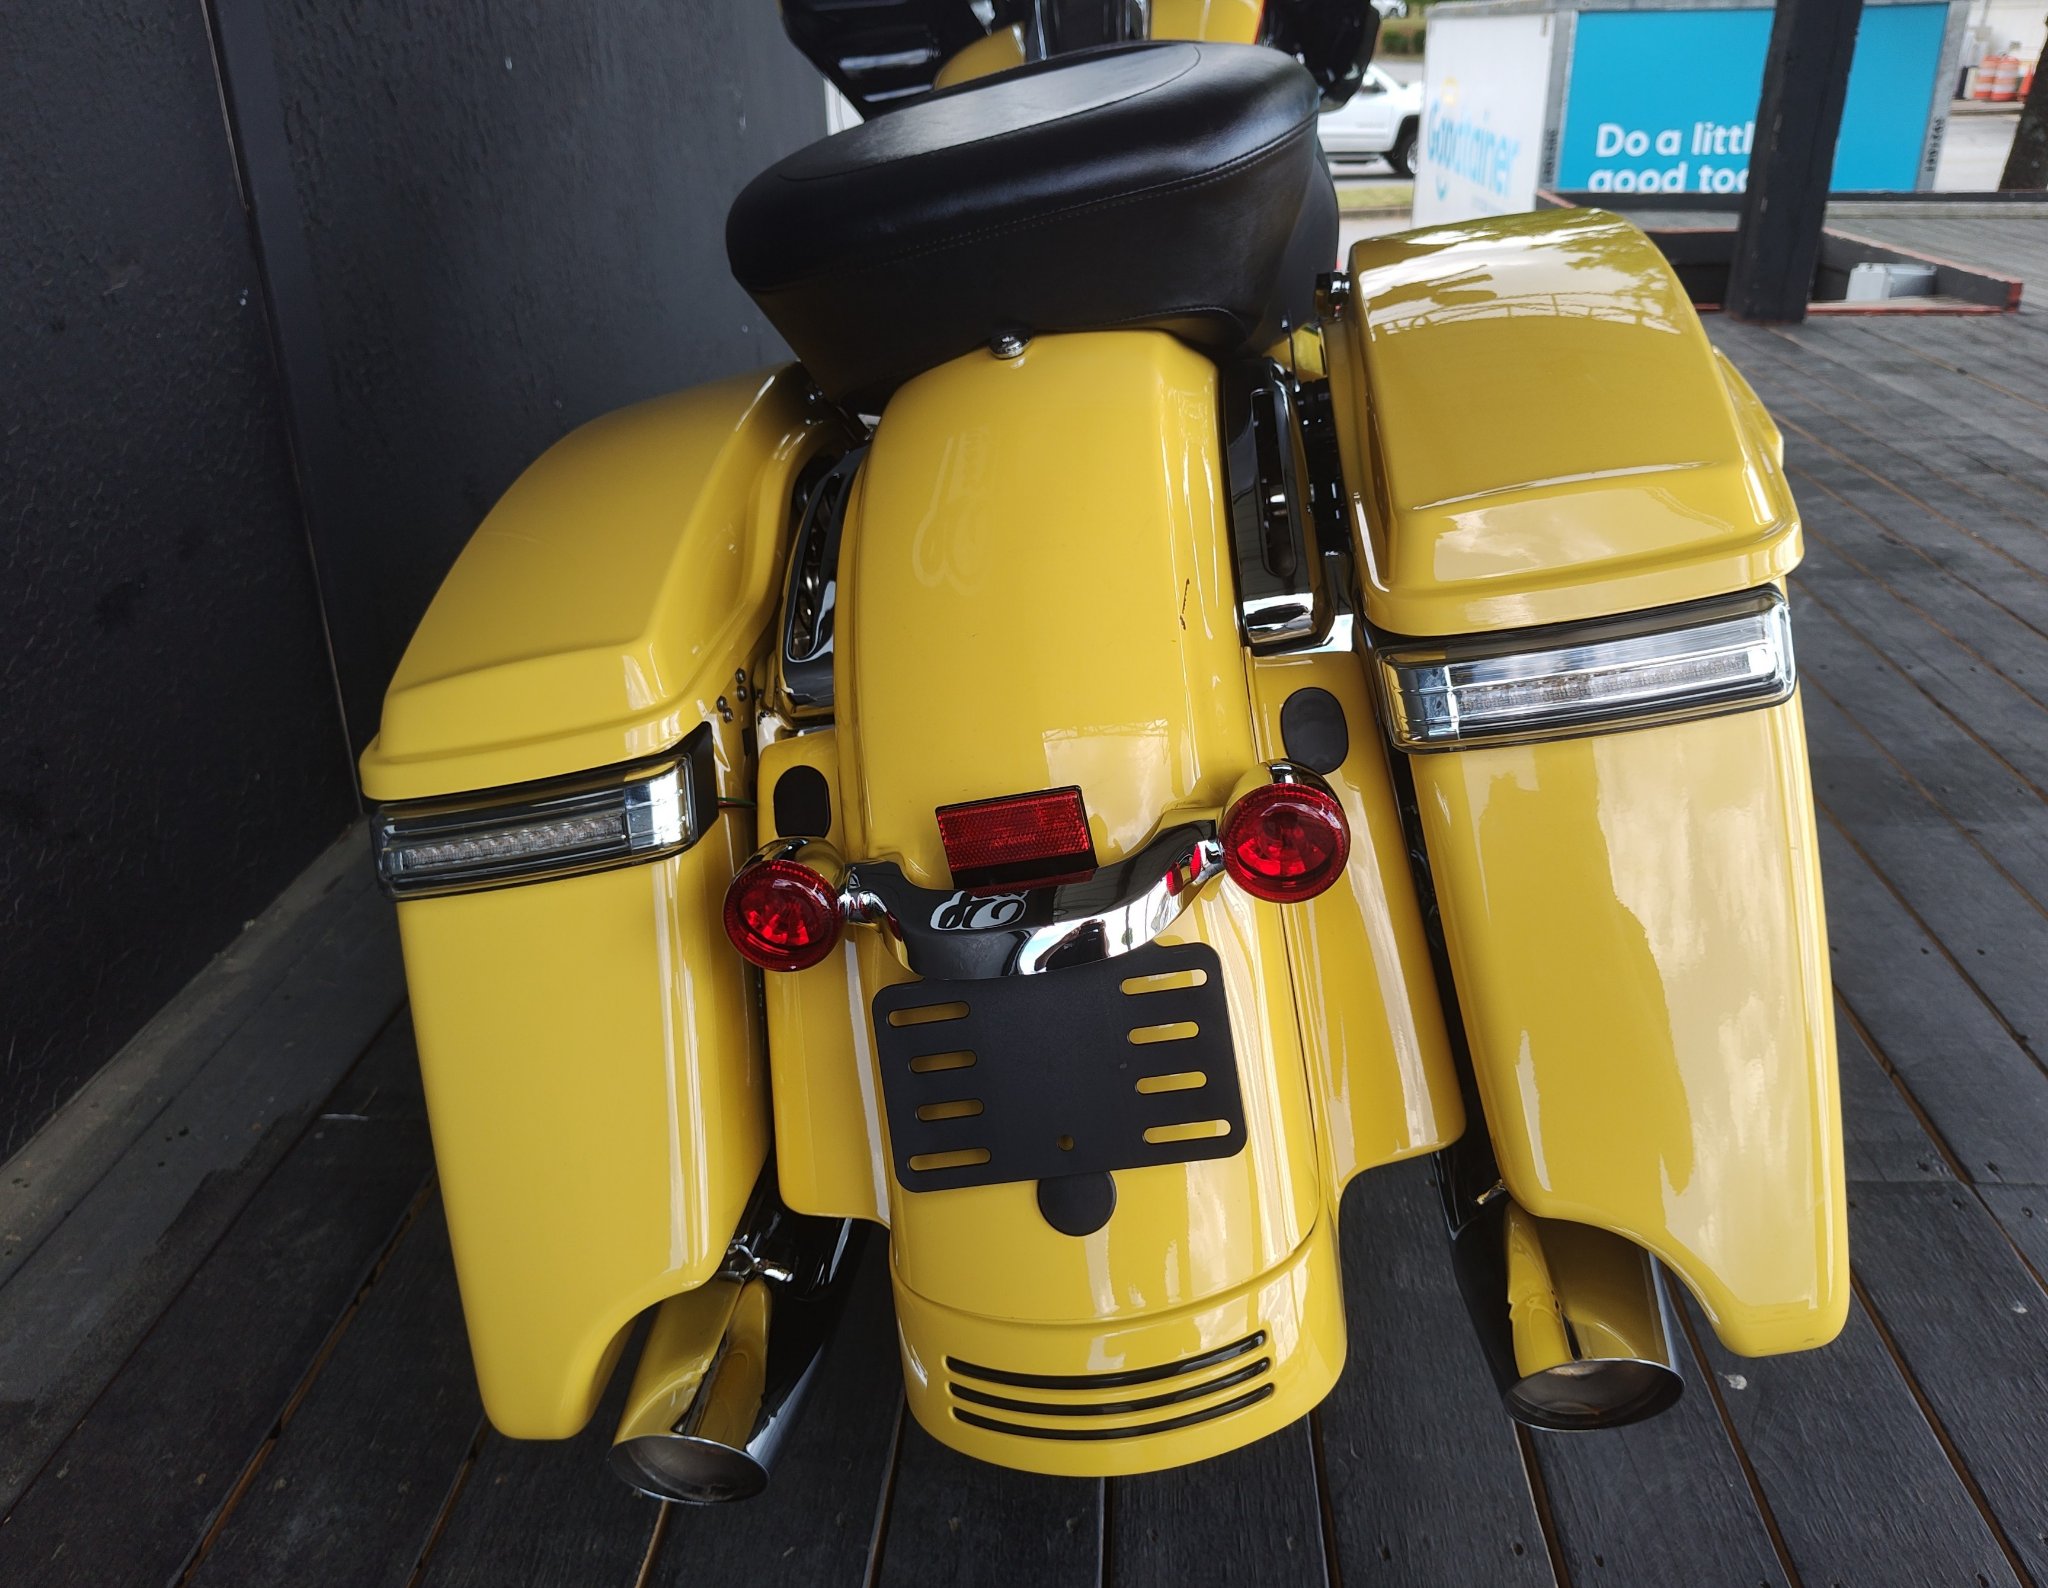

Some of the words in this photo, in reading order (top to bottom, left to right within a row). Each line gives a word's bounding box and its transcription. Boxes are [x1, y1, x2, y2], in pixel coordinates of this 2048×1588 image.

[1595, 122, 1650, 157] Do
[1655, 129, 1682, 156] a
[1691, 120, 1755, 155] littl
